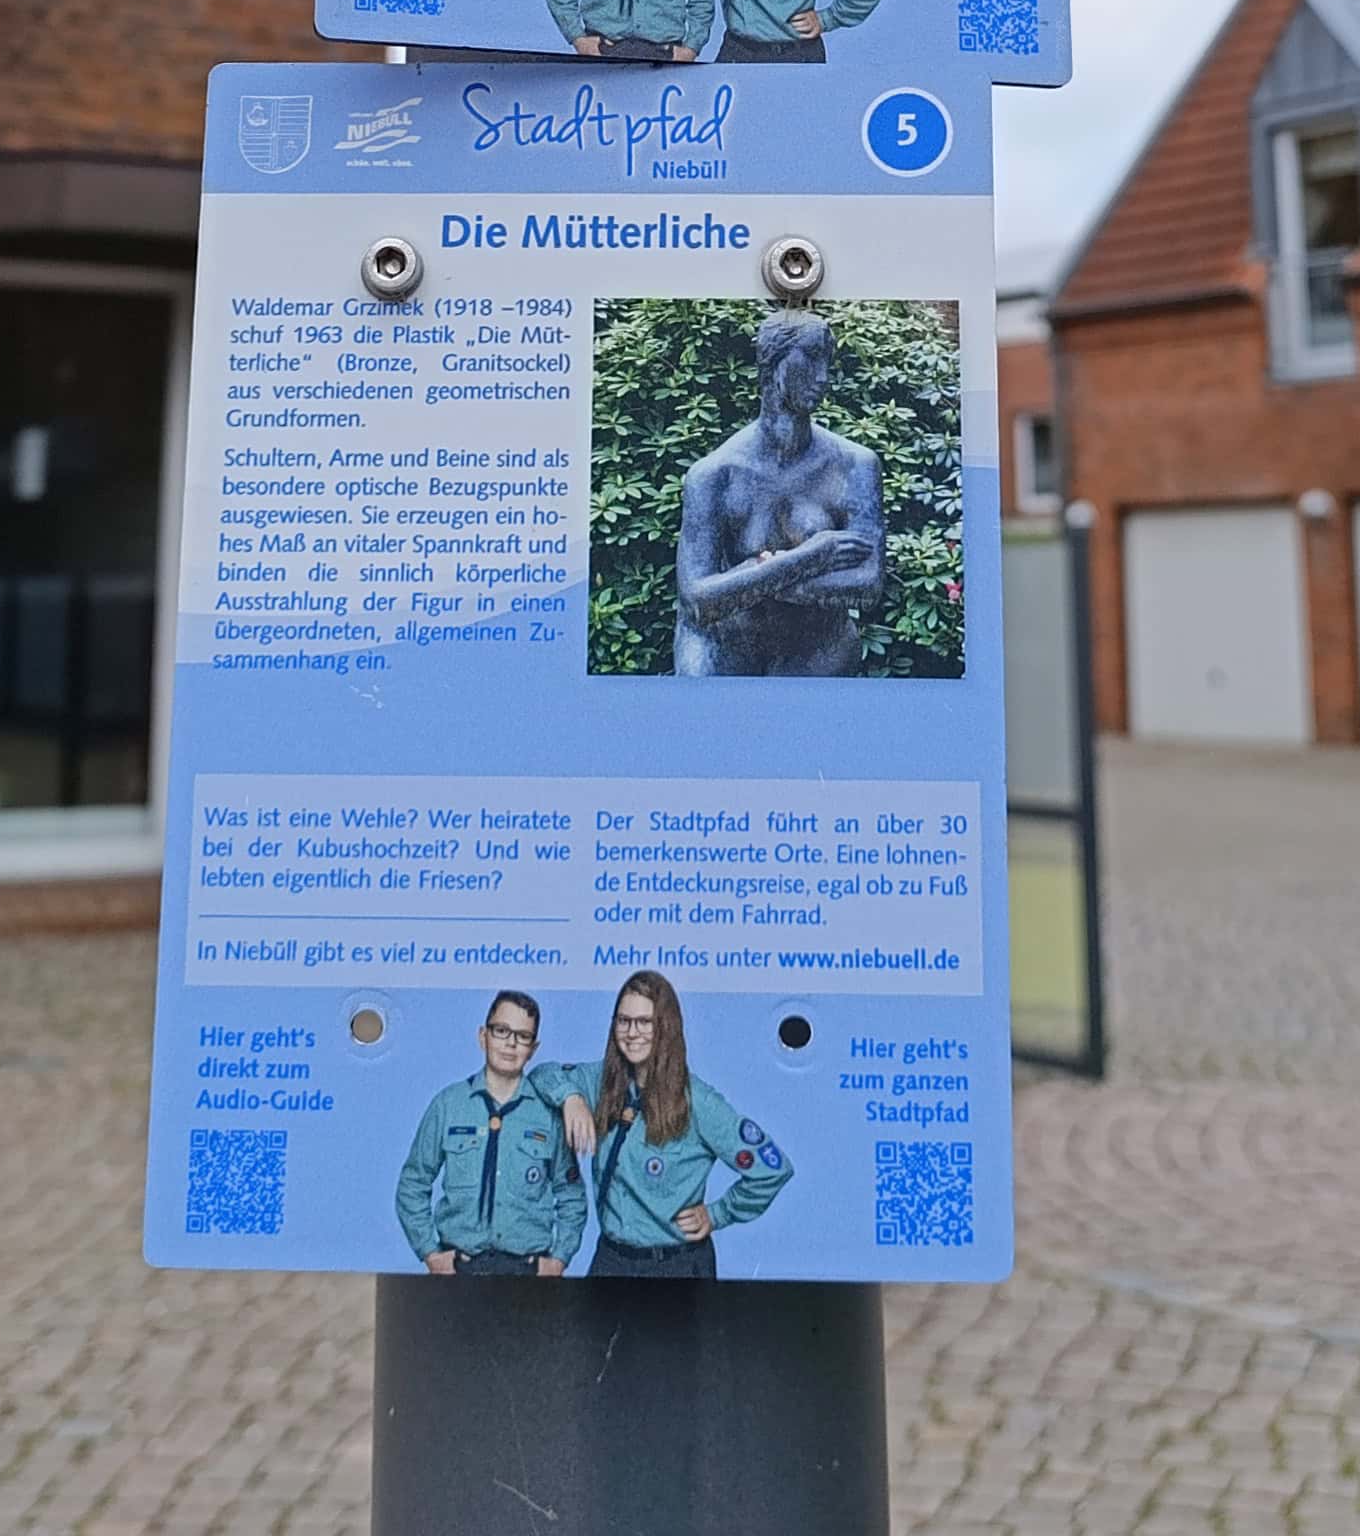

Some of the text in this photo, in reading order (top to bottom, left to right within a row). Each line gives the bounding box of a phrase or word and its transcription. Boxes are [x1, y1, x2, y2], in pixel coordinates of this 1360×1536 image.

[896, 113, 919, 147] 5
[651, 159, 728, 180] Niebüll
[441, 213, 750, 249] Die Mütterliche
[232, 297, 335, 316] Waldemar
[343, 298, 424, 316] Grzimek
[434, 298, 492, 319] (1918
[230, 324, 284, 344] schuf
[294, 326, 343, 344] 1963
[353, 324, 384, 344] die
[393, 325, 455, 344] Plastik
[520, 326, 571, 344] Müt-
[337, 353, 418, 375] (Bronze,
[442, 352, 571, 374] Granitsockel)
[227, 380, 570, 405] aus verschiedenen geometrischen
[226, 408, 366, 428] Grundformen.
[224, 447, 569, 470] Schultern, Arme und Beine sind als
[222, 475, 568, 502] besondere optische Bezugspunkte
[220, 505, 566, 530] ausgewiesen. Sie erzeugen ein ho-
[220, 533, 566, 559] hes Maß an vitaler Spannkraft und
[218, 562, 566, 588] binden die sinnlich körperliche
[216, 591, 565, 616] Ausstrahlung der Figur in einen
[215, 620, 563, 646] übergeordneten, allgemeinen Zu-
[213, 650, 392, 675] sammenhang ein.
[204, 807, 571, 832] Was ist eine Wehle? Wer heiratete
[596, 810, 967, 838] Der Stadtpfad führt an über 30
[202, 835, 571, 861] bei der Kubushochzeit? Und wie
[596, 840, 966, 865] bemerkenswerte Orte. Eine lohnen-
[201, 865, 503, 894] lebten eigentlich die Friesen?
[594, 870, 968, 900] de Entdeckungsreise, egal ob zu Fuß
[594, 900, 827, 926] oder mit dem Fahrrad.
[198, 939, 568, 967] In Niebüll gibt es viel zu entdecken.
[593, 944, 960, 971] Mehr Infos unter www.niebuell.de
[200, 1026, 245, 1047] Hier
[851, 1037, 896, 1059] Hier
[198, 1056, 310, 1080] direkt zum
[840, 1073, 968, 1096] zum ganzen
[195, 1088, 334, 1112] Audio-Guide
[866, 1100, 969, 1129] Stadtpfad
